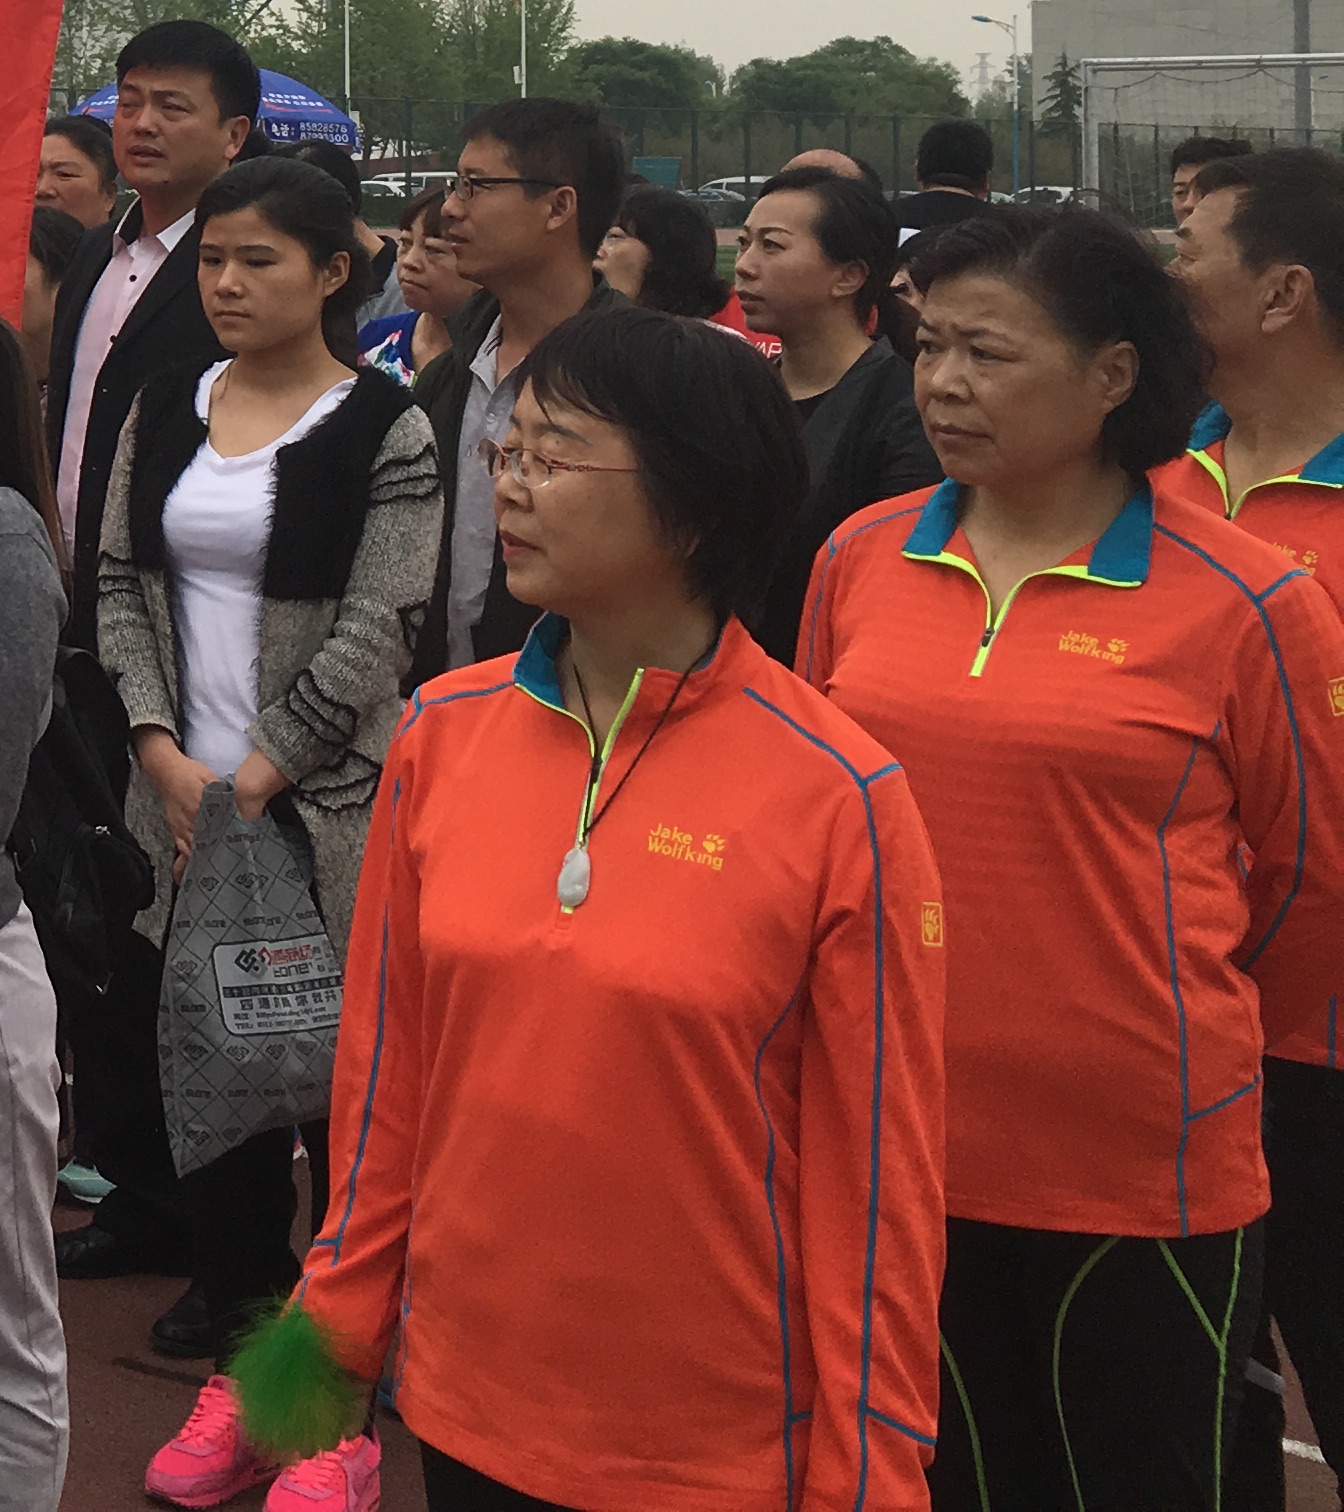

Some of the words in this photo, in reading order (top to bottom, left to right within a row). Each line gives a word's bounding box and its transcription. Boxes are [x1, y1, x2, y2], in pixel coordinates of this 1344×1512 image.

[1060, 630, 1100, 646] Jake
[650, 822, 694, 845] Jake
[647, 835, 724, 871] Wolfking
